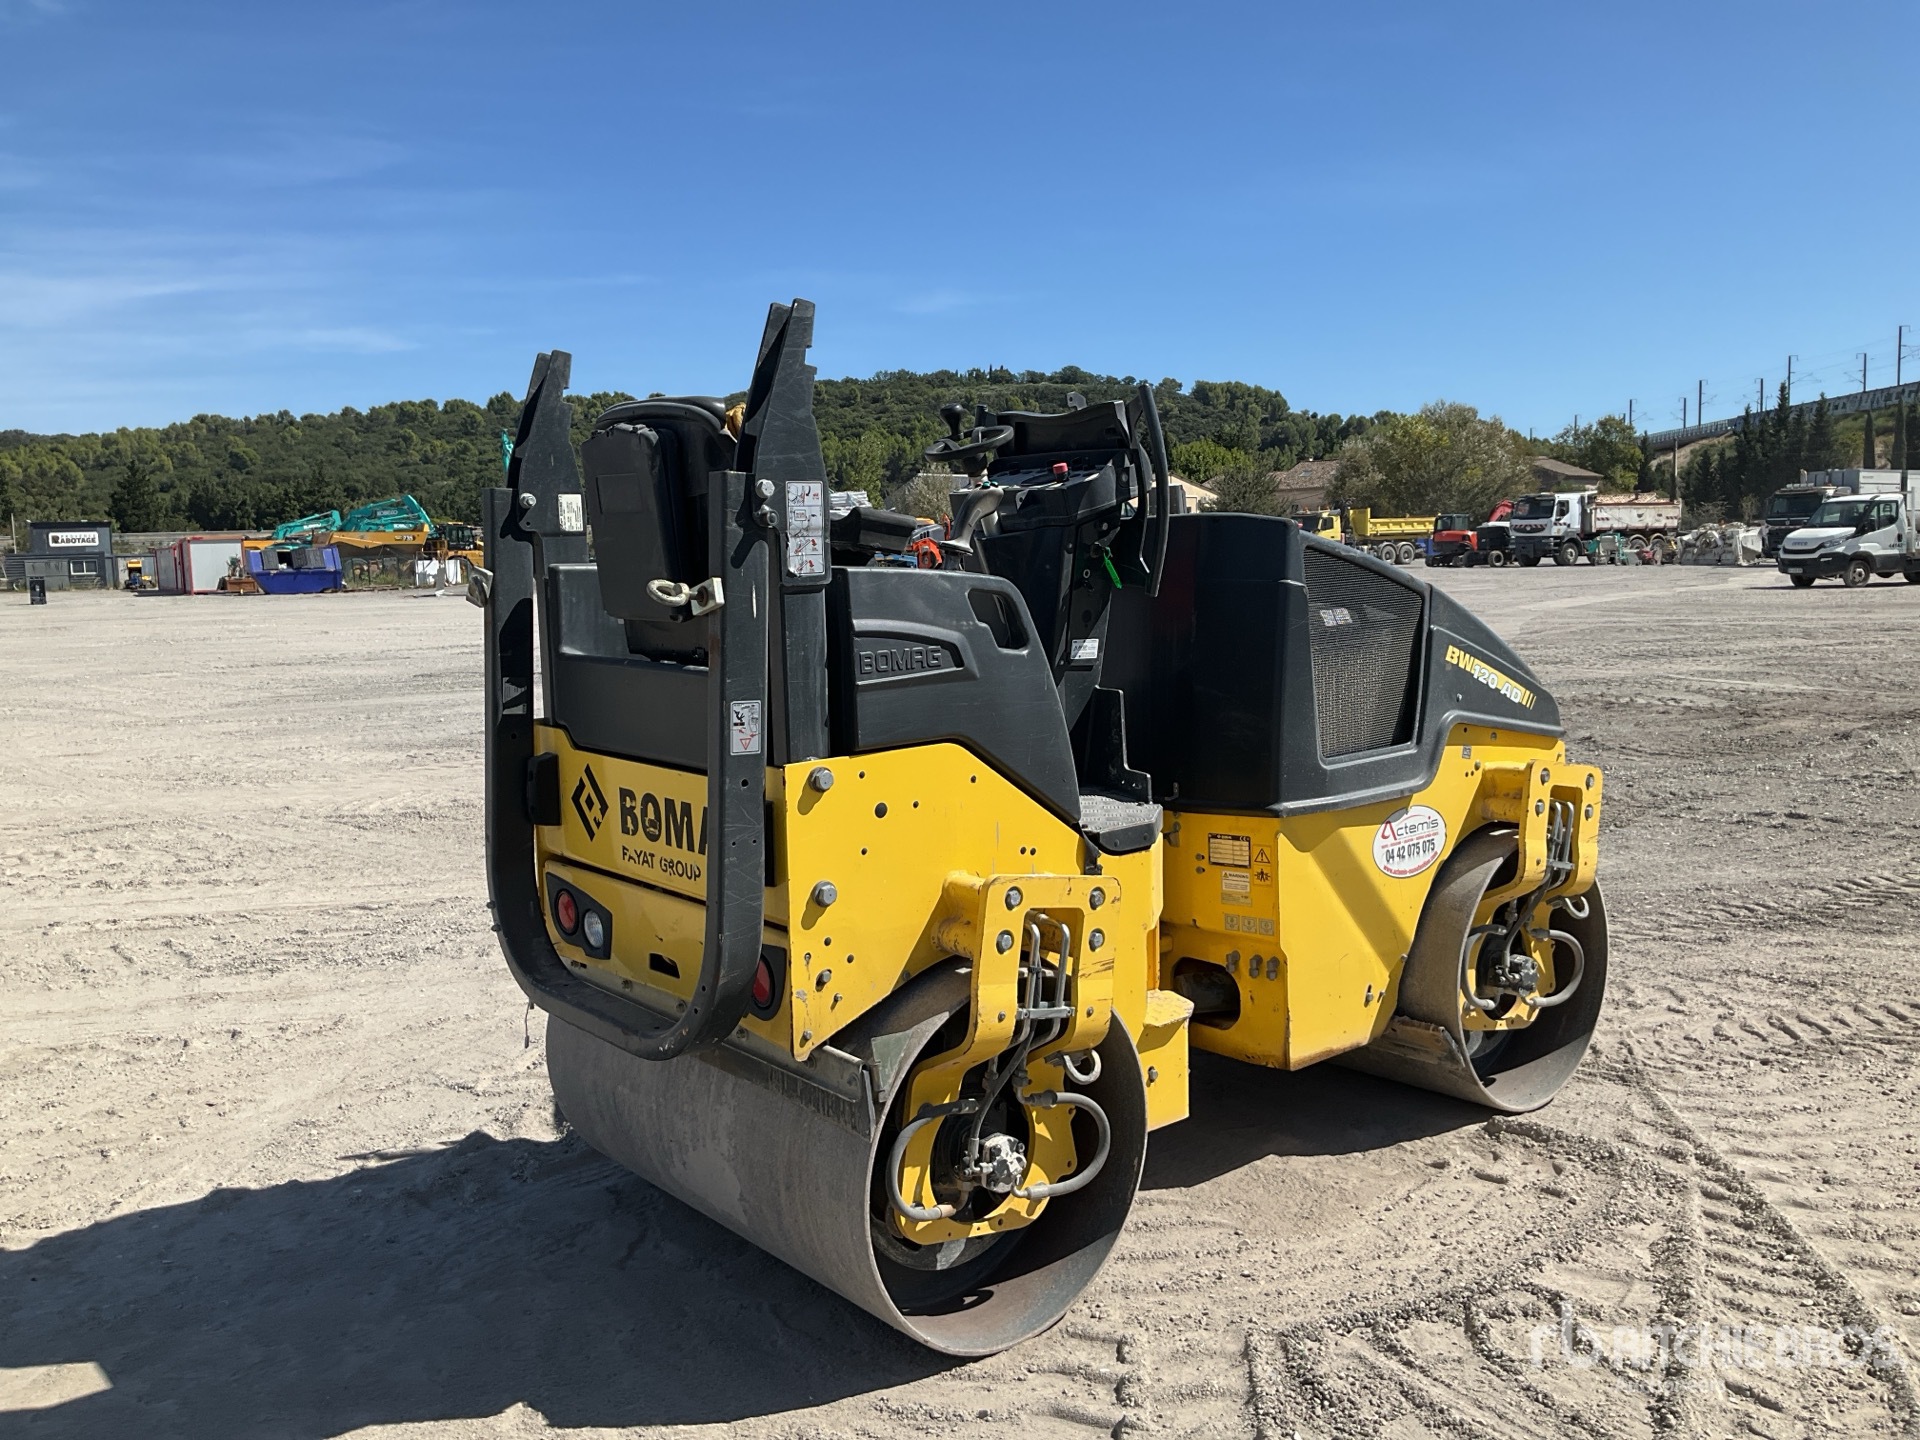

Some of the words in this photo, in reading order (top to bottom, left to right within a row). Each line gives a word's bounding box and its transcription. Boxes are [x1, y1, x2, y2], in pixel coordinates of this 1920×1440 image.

[51, 535, 96, 544] RABOTAGE
[858, 645, 942, 675] BOMAG
[1500, 682, 1522, 704] AD
[1381, 815, 1439, 841] Actemis
[622, 845, 655, 869] FAYAT
[660, 857, 702, 881] GROUP
[1385, 848, 1395, 863] 04
[1396, 846, 1406, 860] 42
[1407, 841, 1421, 857] 075
[1422, 838, 1436, 854] 075
